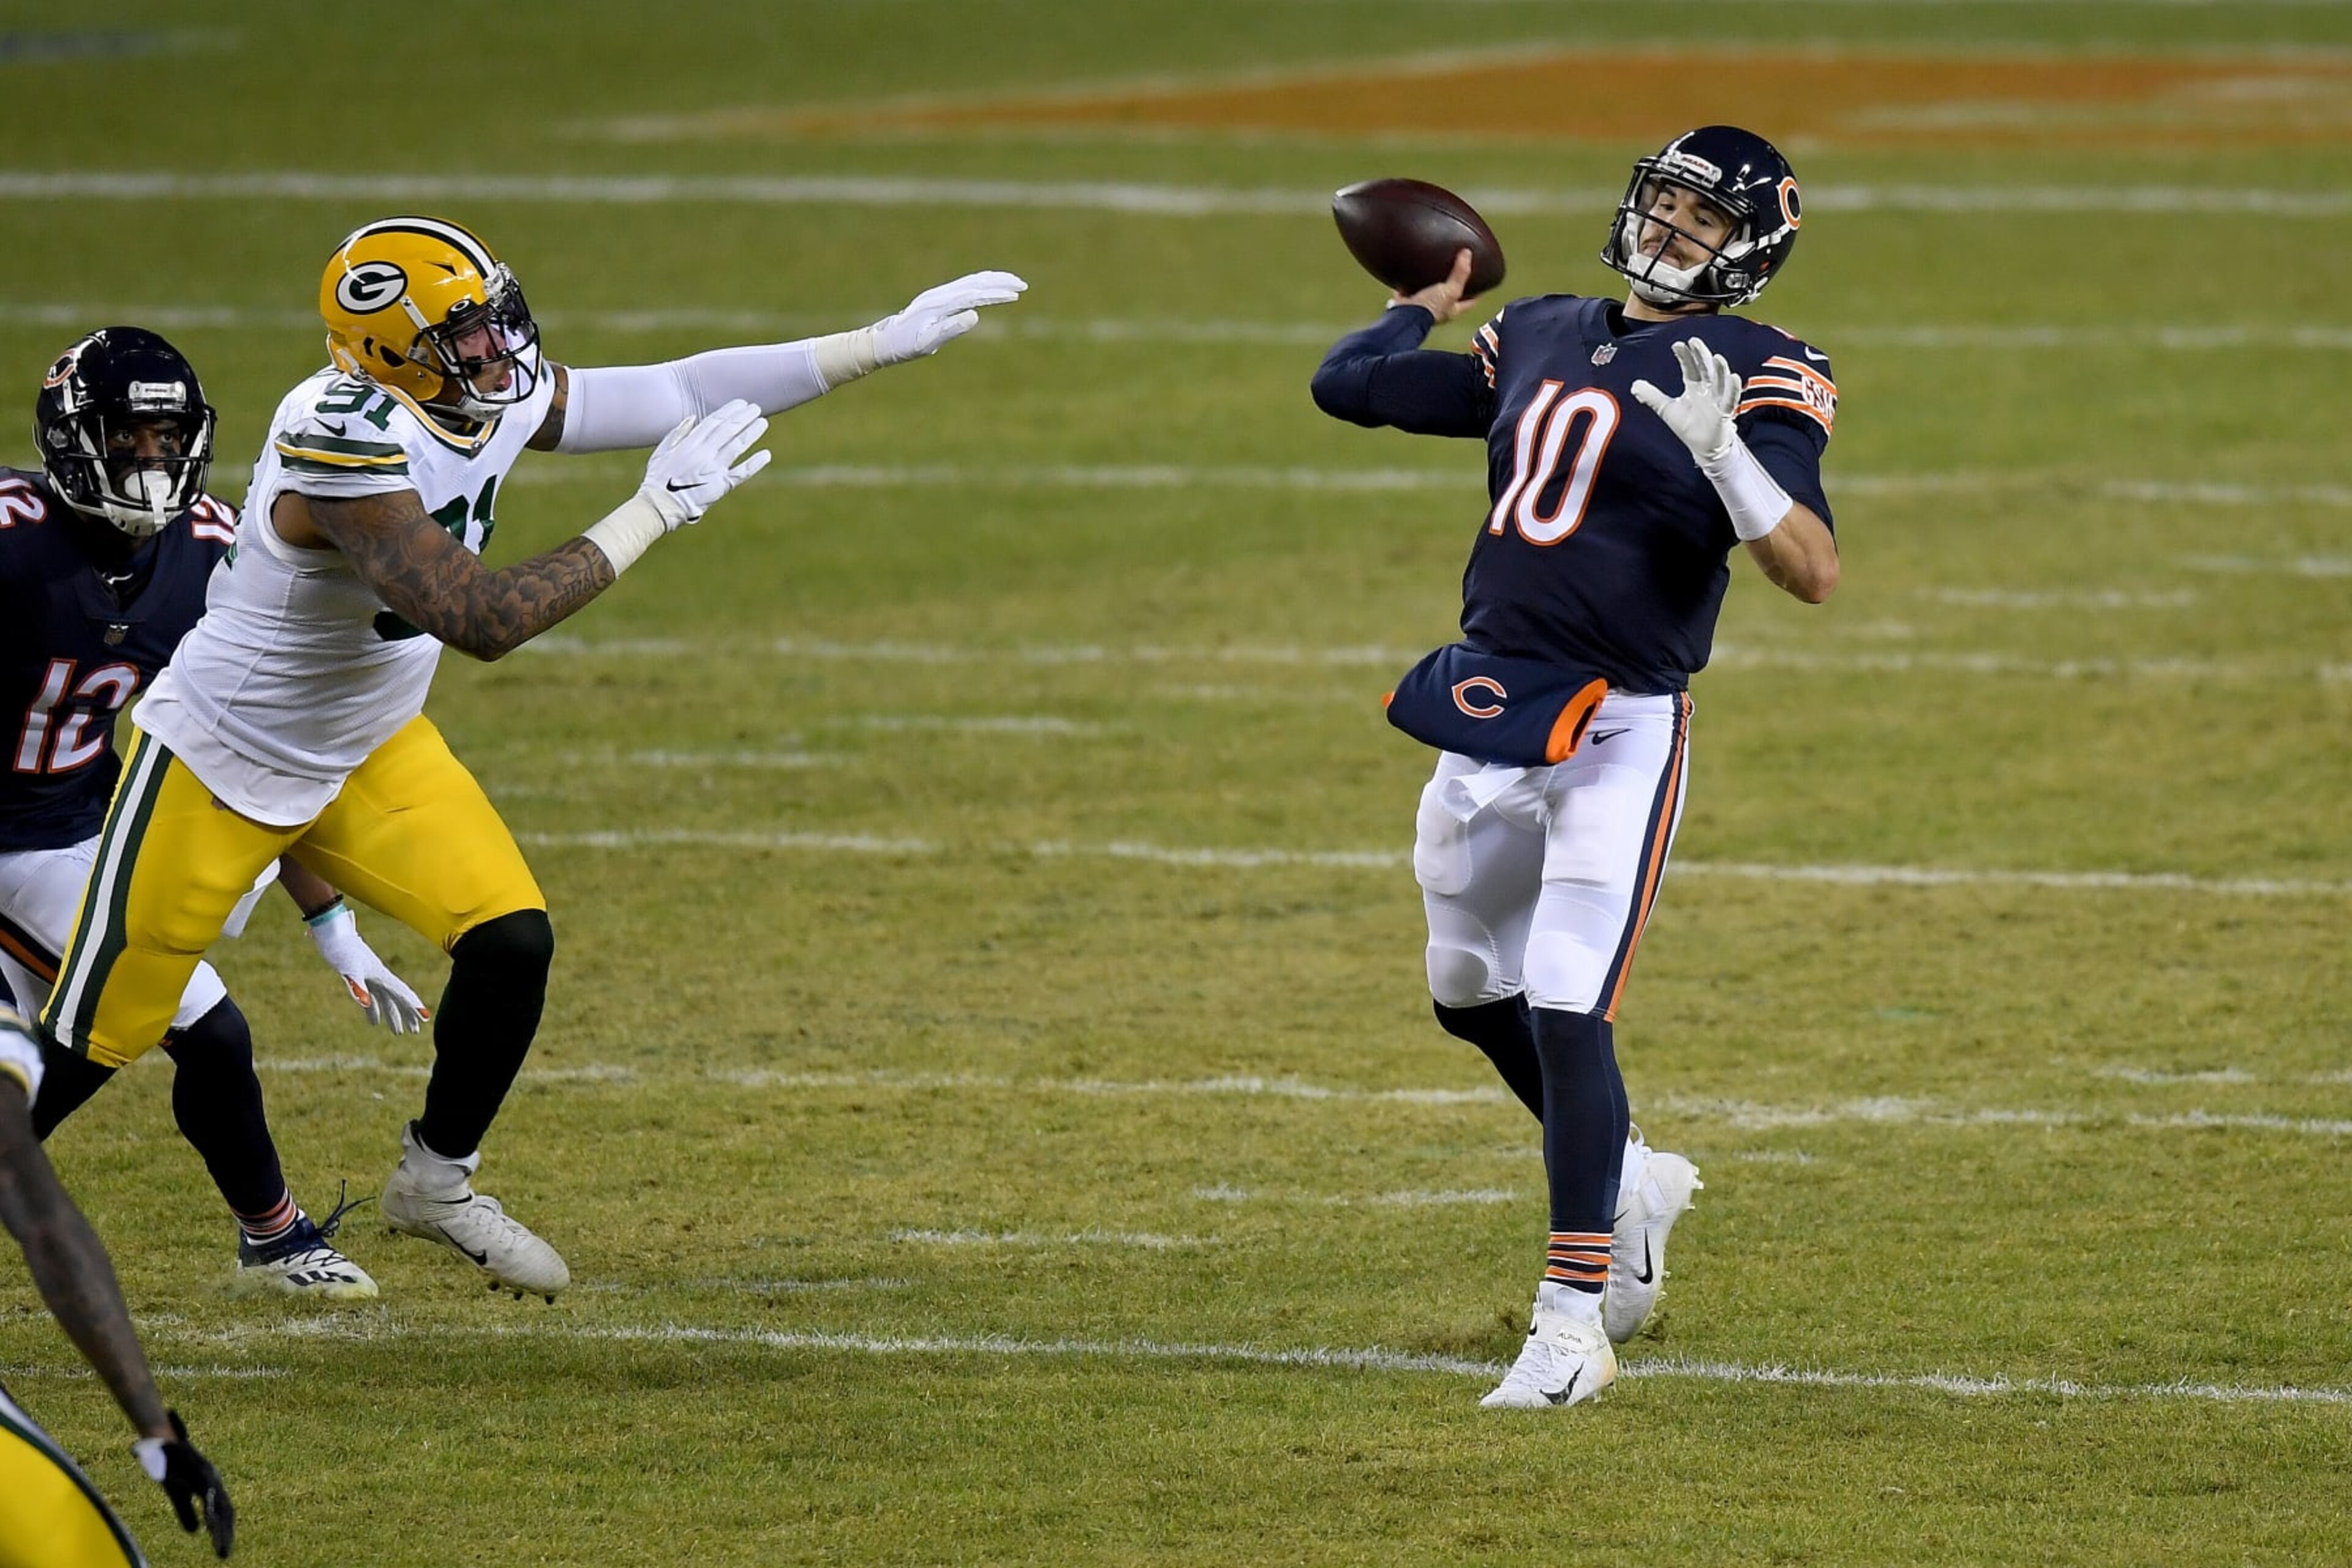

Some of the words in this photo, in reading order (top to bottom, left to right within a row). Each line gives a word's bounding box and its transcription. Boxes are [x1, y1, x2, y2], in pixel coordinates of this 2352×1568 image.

[337, 261, 407, 314] G
[315, 382, 398, 431] 91
[1488, 379, 1621, 546] 10
[13, 657, 140, 774] 12
[1452, 676, 1507, 719] C
